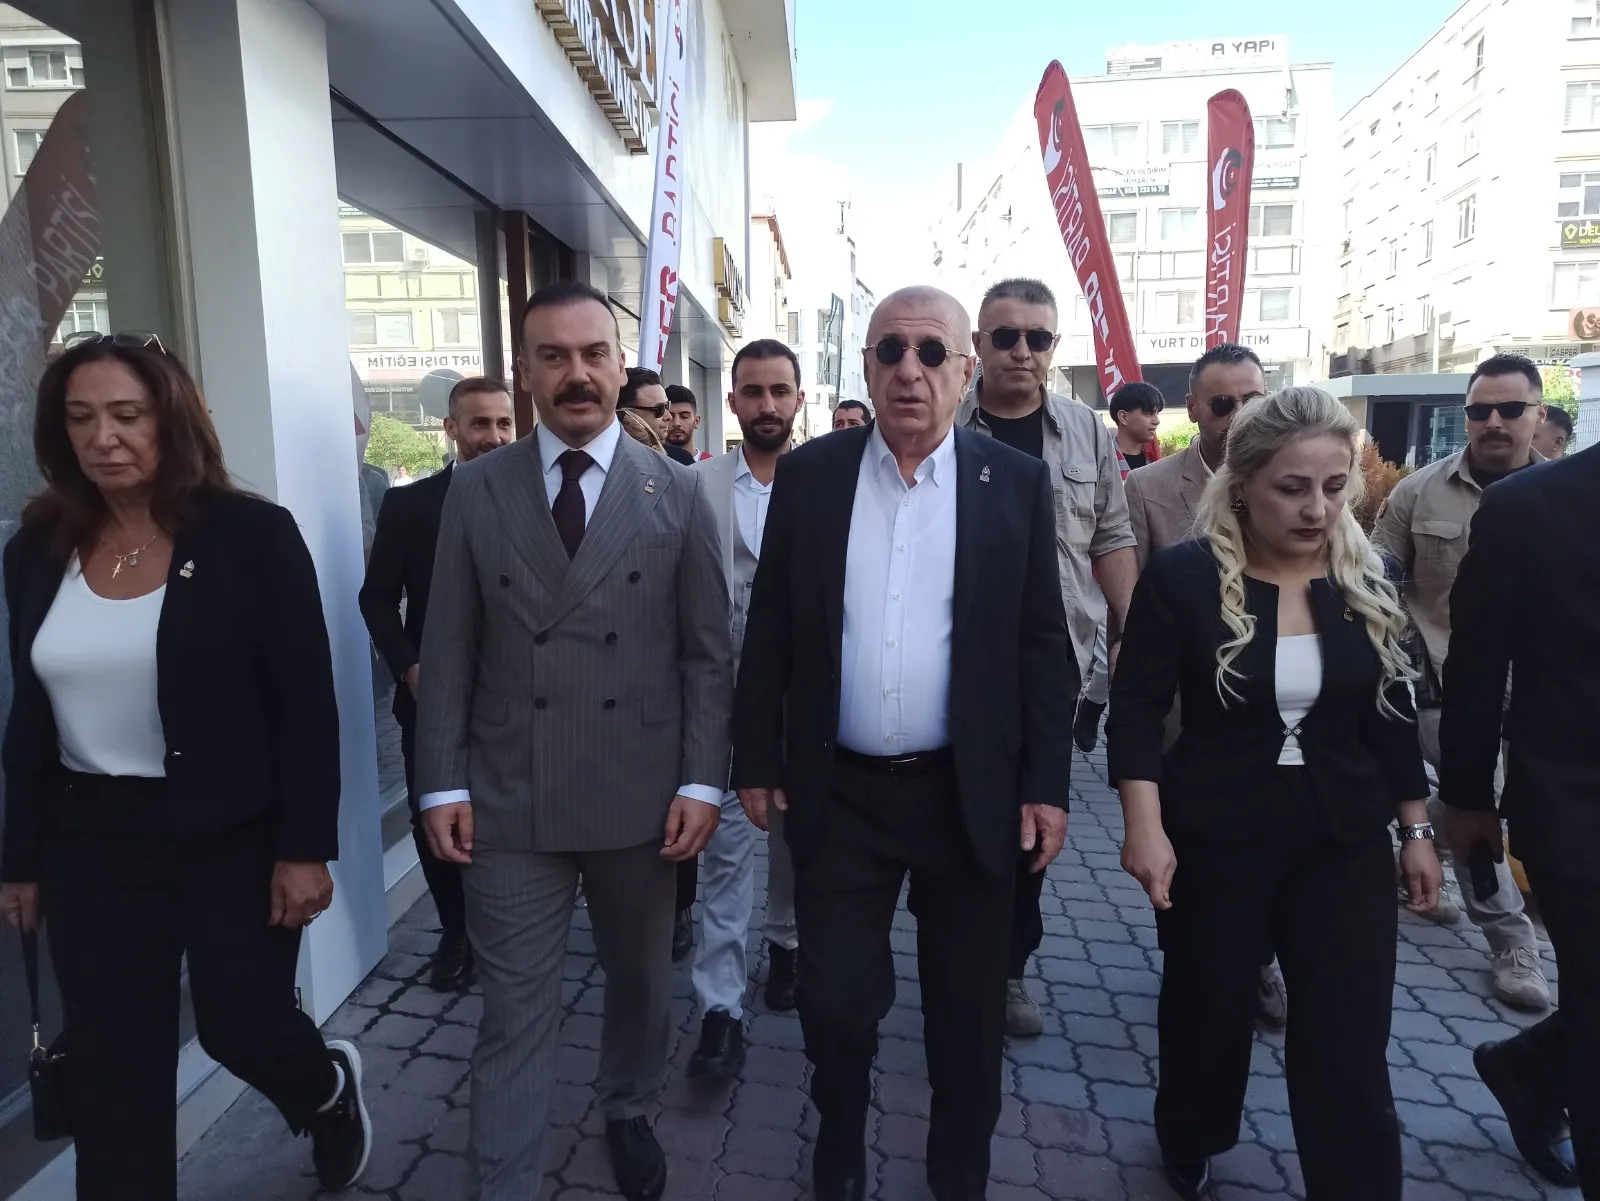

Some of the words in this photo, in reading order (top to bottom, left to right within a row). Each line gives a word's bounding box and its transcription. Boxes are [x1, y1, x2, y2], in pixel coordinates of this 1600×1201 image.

[1231, 40, 1275, 53] YAPI
[1150, 337, 1186, 348] YURT
[1190, 337, 1203, 348] DI
[1551, 348, 1578, 357] CASPER
